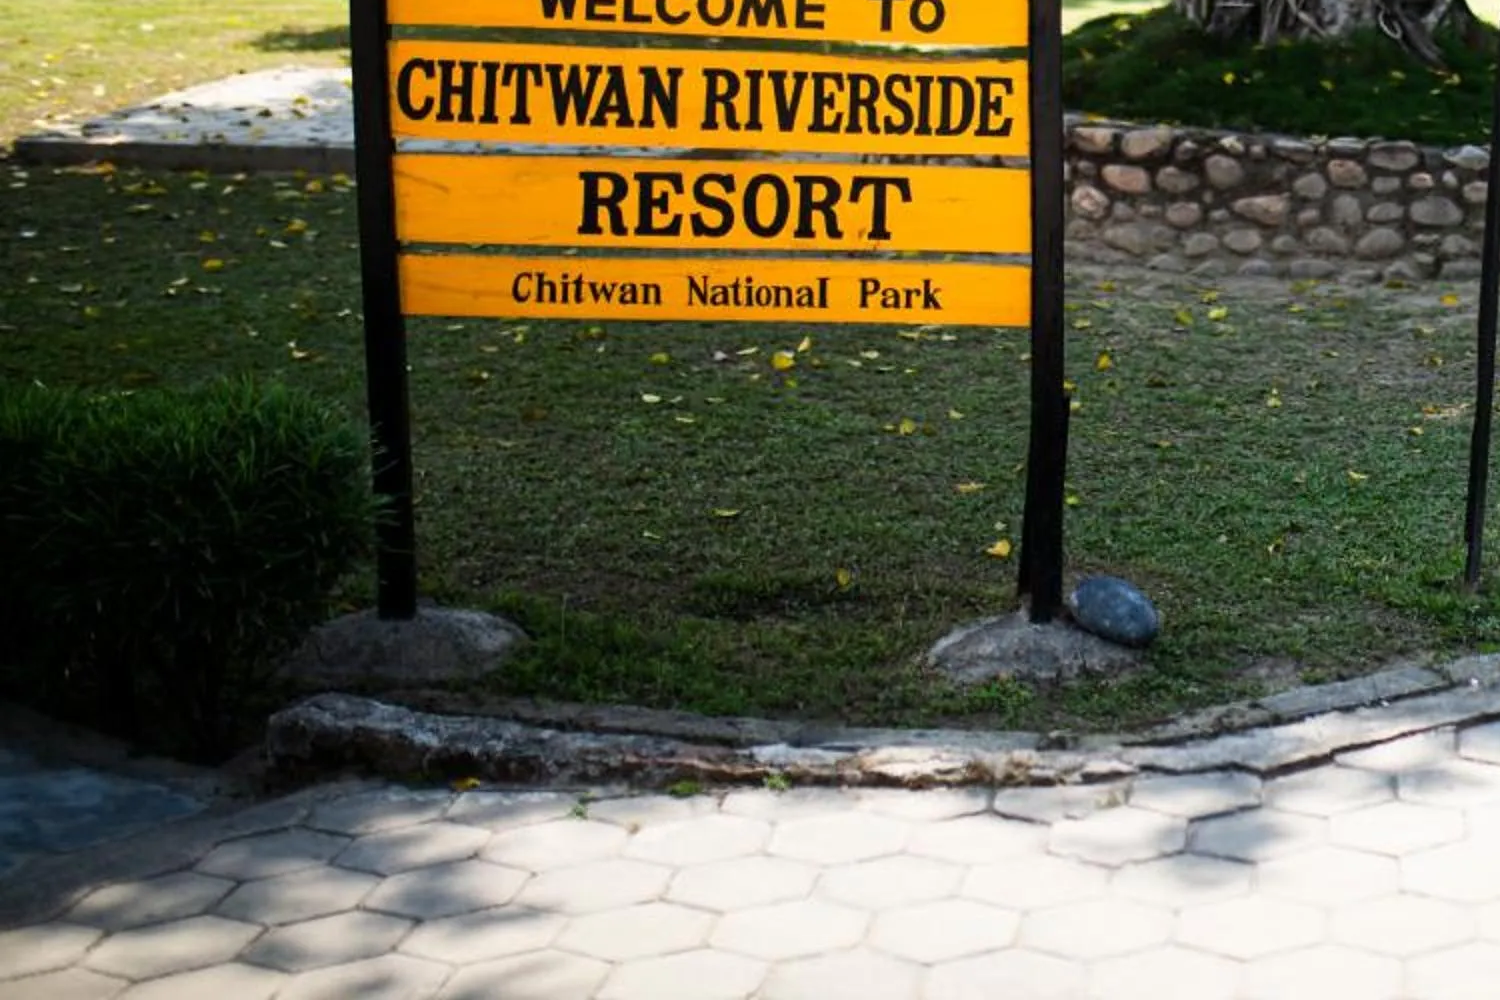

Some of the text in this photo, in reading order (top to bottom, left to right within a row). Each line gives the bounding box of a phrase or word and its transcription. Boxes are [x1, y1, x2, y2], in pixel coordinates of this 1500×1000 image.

[395, 57, 1015, 138] CHITWAN RIVERSIDE
[577, 170, 912, 241] RESORT
[511, 271, 942, 311] Chitwan National Park
